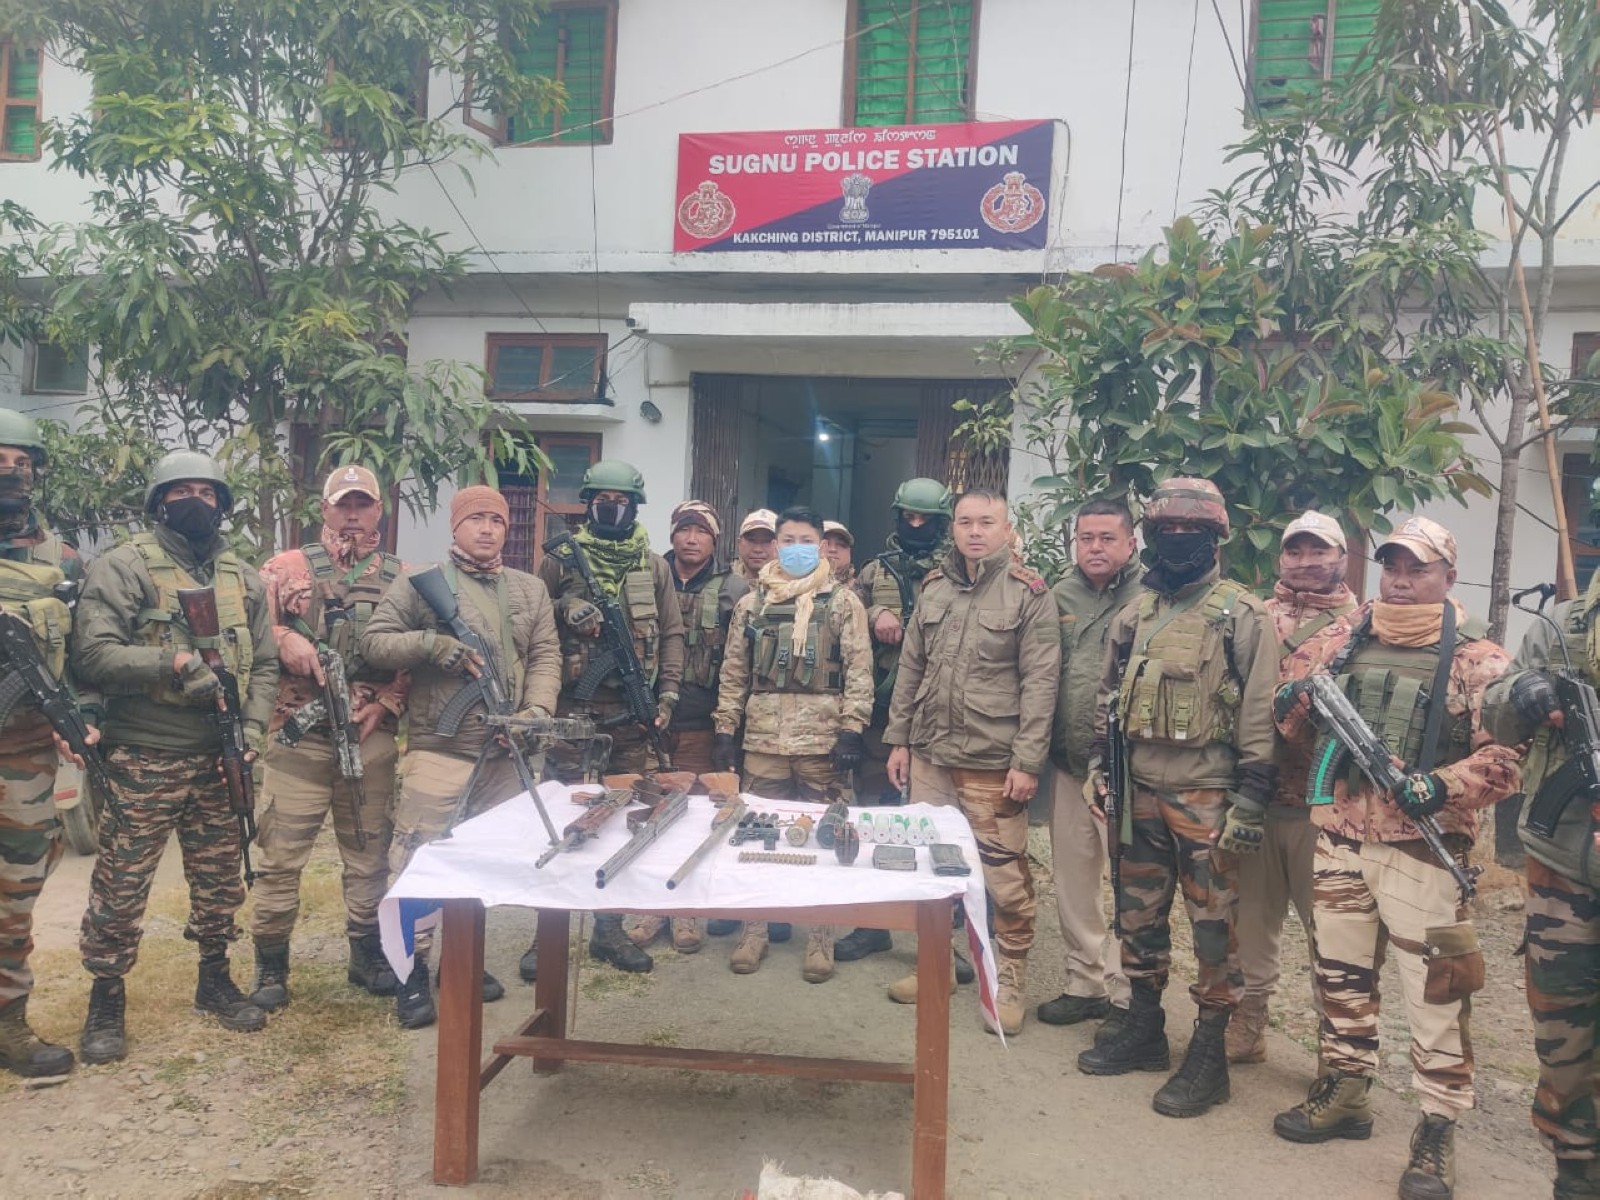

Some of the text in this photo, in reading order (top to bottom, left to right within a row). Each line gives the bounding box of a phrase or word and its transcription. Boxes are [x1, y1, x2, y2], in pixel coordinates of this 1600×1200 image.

[708, 145, 1019, 175] SUGNU POLICE STATION
[733, 228, 980, 245] KAKCHING DISTRICT, MANIPUR 795101
